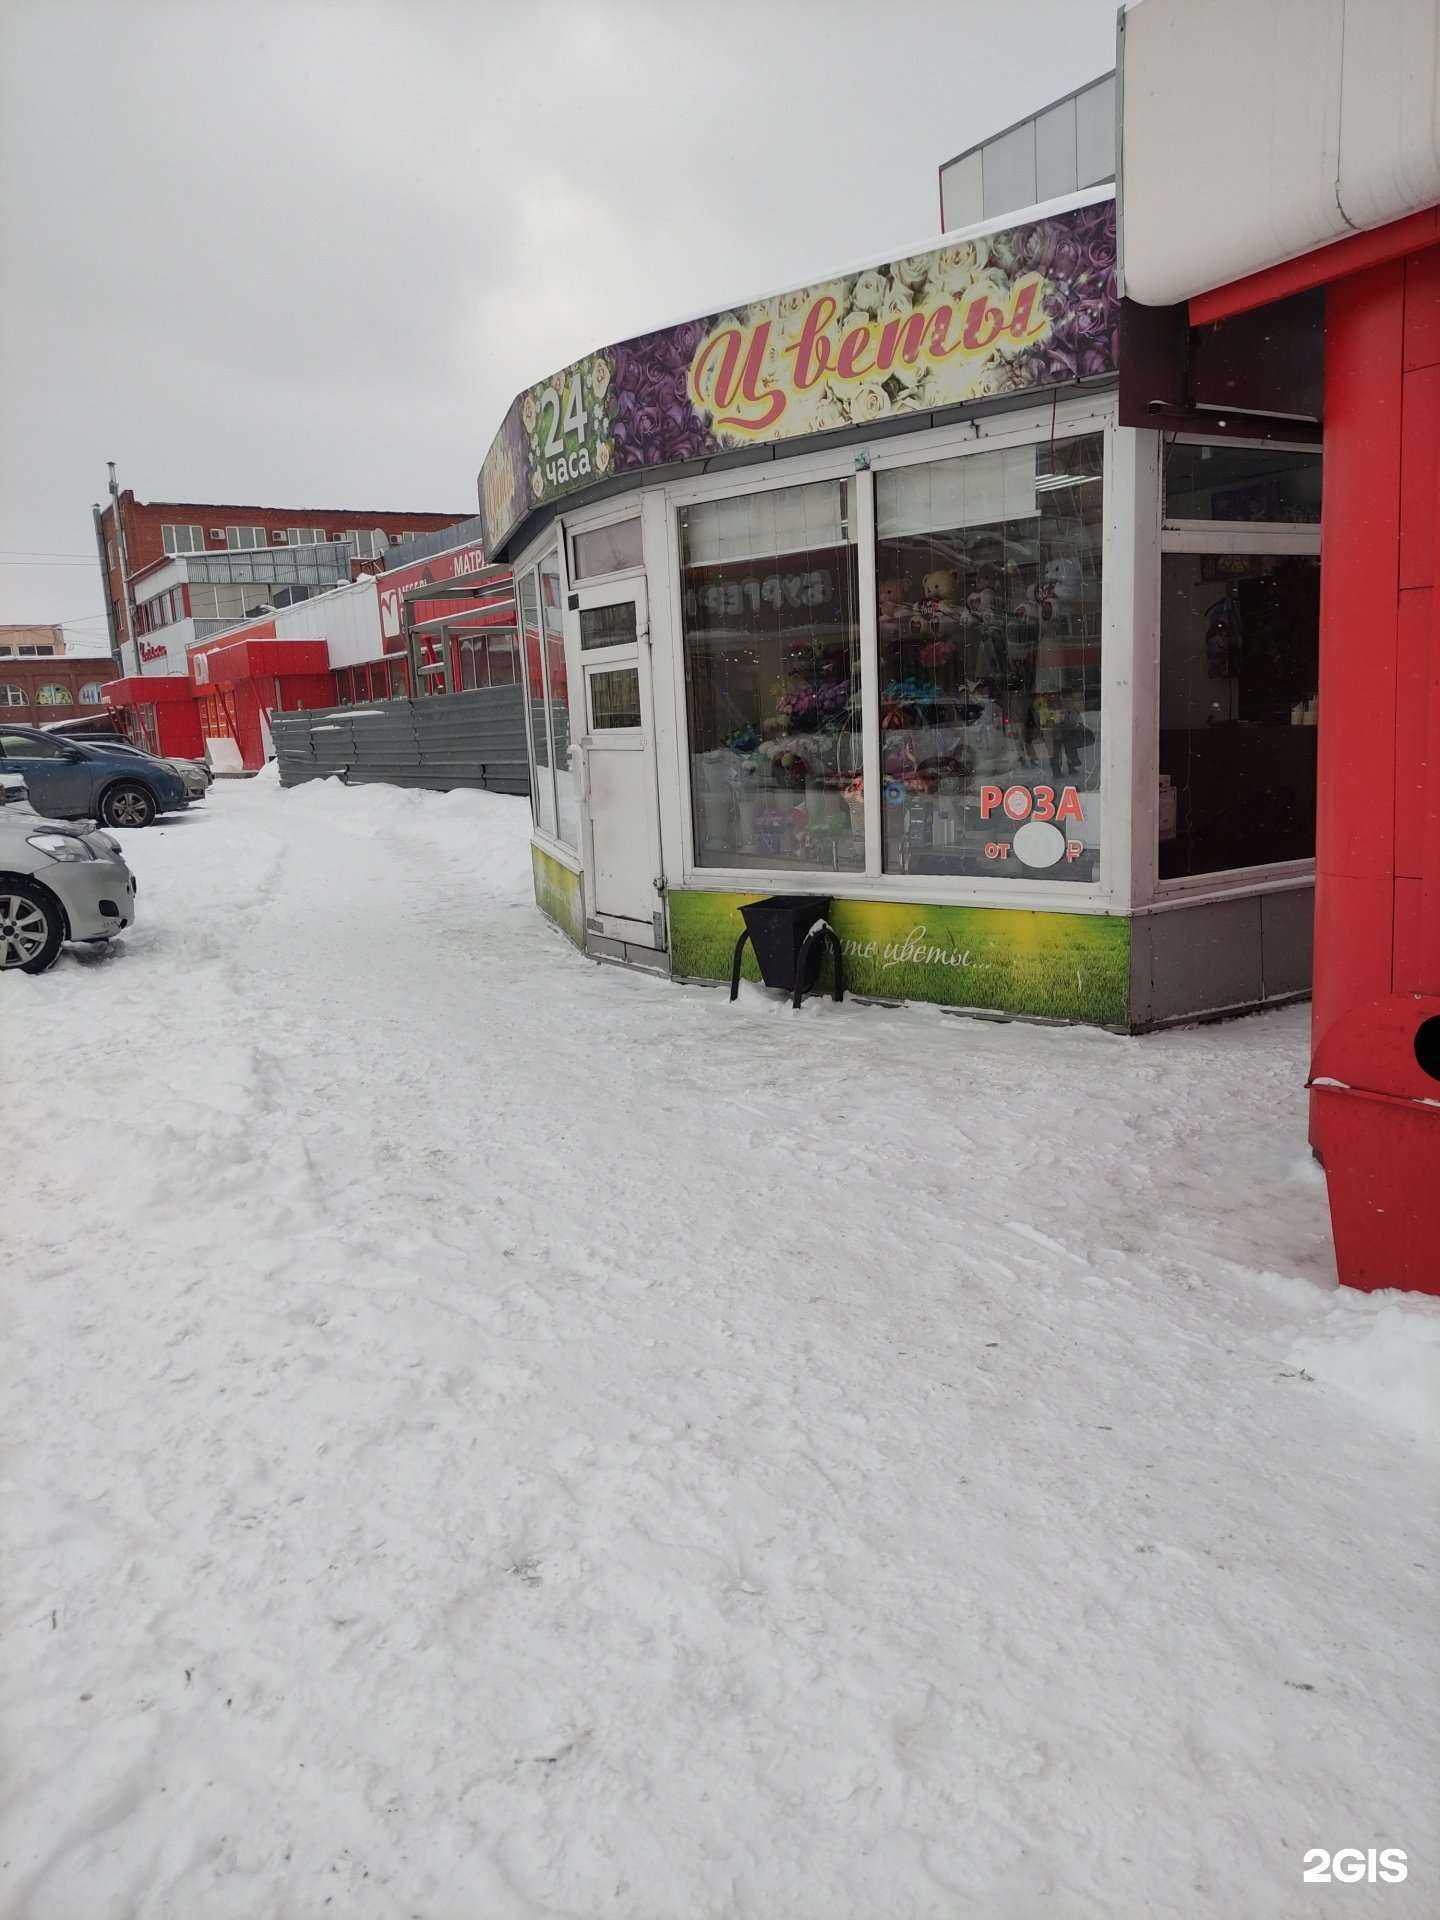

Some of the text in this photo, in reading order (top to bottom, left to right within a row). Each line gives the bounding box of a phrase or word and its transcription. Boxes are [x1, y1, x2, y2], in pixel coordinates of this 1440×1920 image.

[695, 278, 1046, 431] Цветы
[541, 374, 588, 458] 24
[546, 447, 591, 486] часа
[980, 785, 1084, 821] РОЗА
